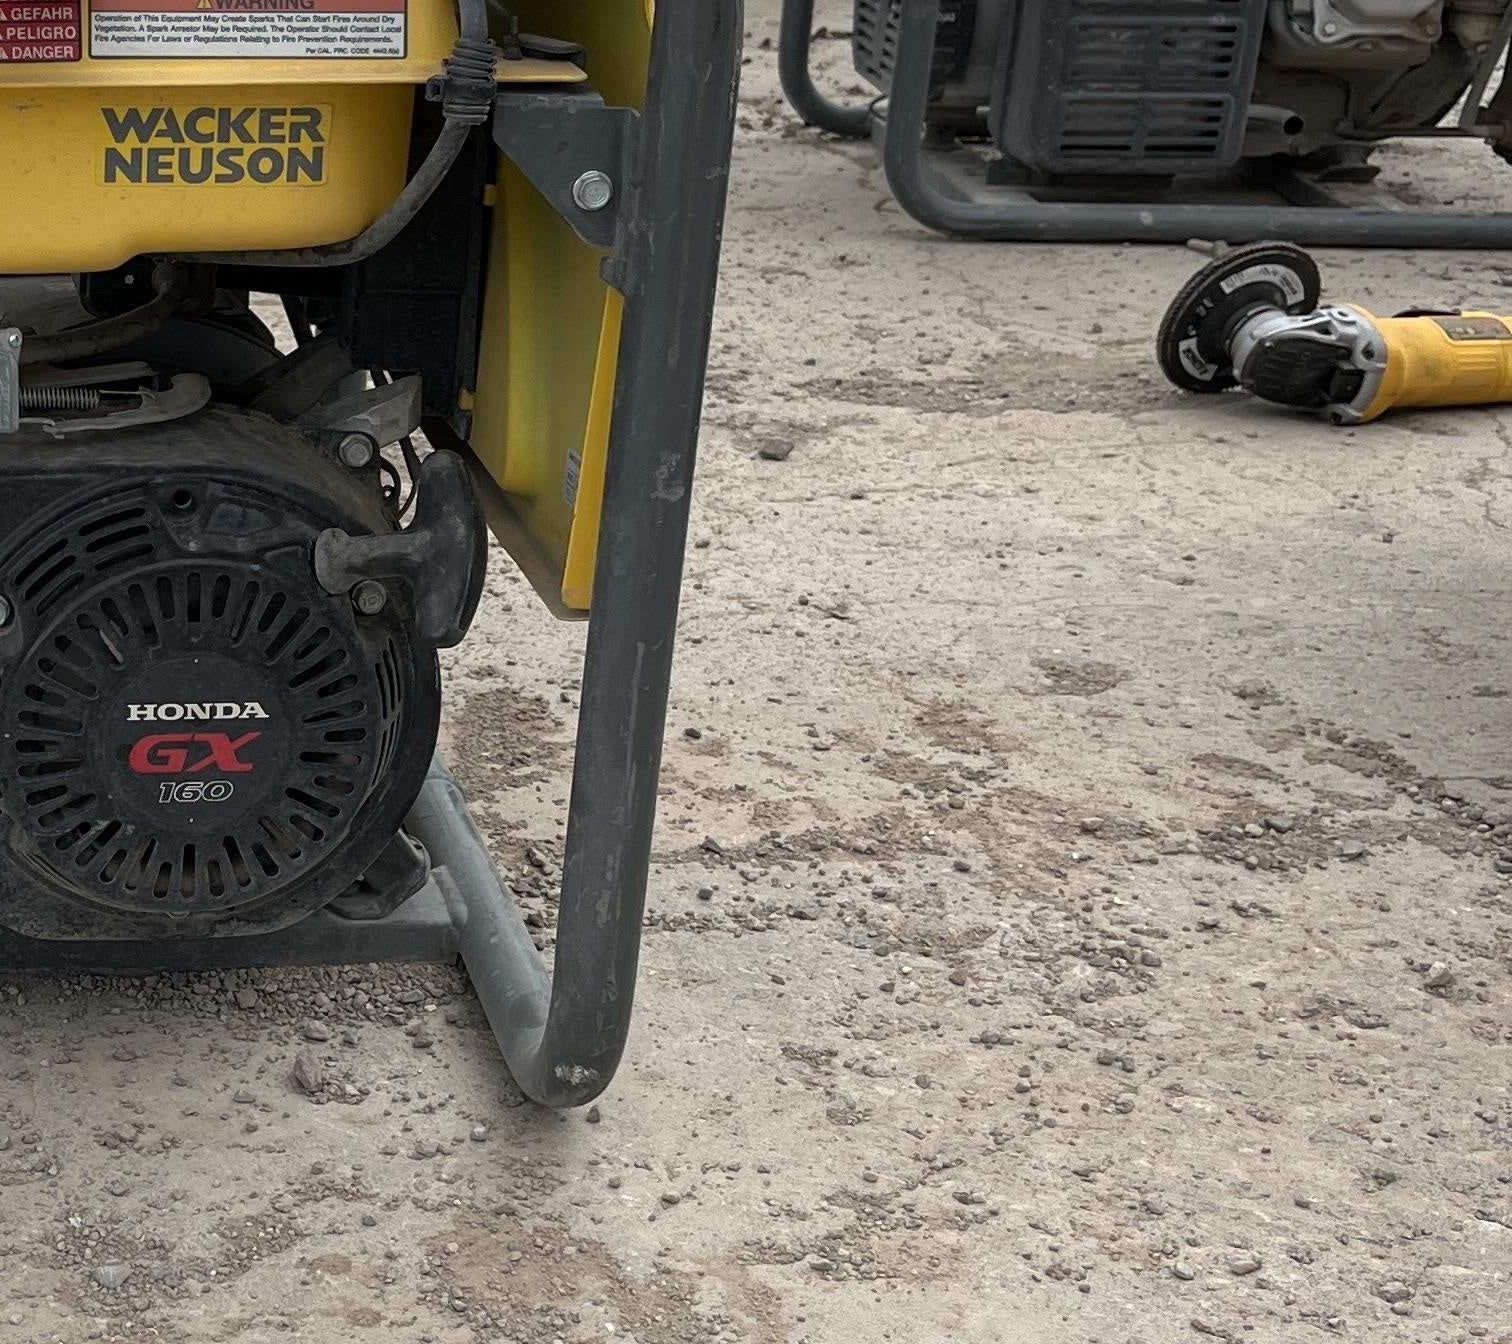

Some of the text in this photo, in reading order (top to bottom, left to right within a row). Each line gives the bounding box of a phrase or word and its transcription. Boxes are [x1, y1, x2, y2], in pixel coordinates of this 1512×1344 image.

[10, 8, 73, 20] GEFAHR
[95, 15, 132, 23] Operation
[161, 15, 201, 23] Equipment
[7, 26, 77, 40] PELIGRO
[111, 35, 145, 43] Agencies
[11, 47, 74, 59] DANGER
[101, 107, 325, 144] WACKER
[104, 146, 324, 184] NEUSON
[126, 702, 271, 721] HONDA
[128, 732, 263, 775] GX
[159, 780, 234, 804] 160
